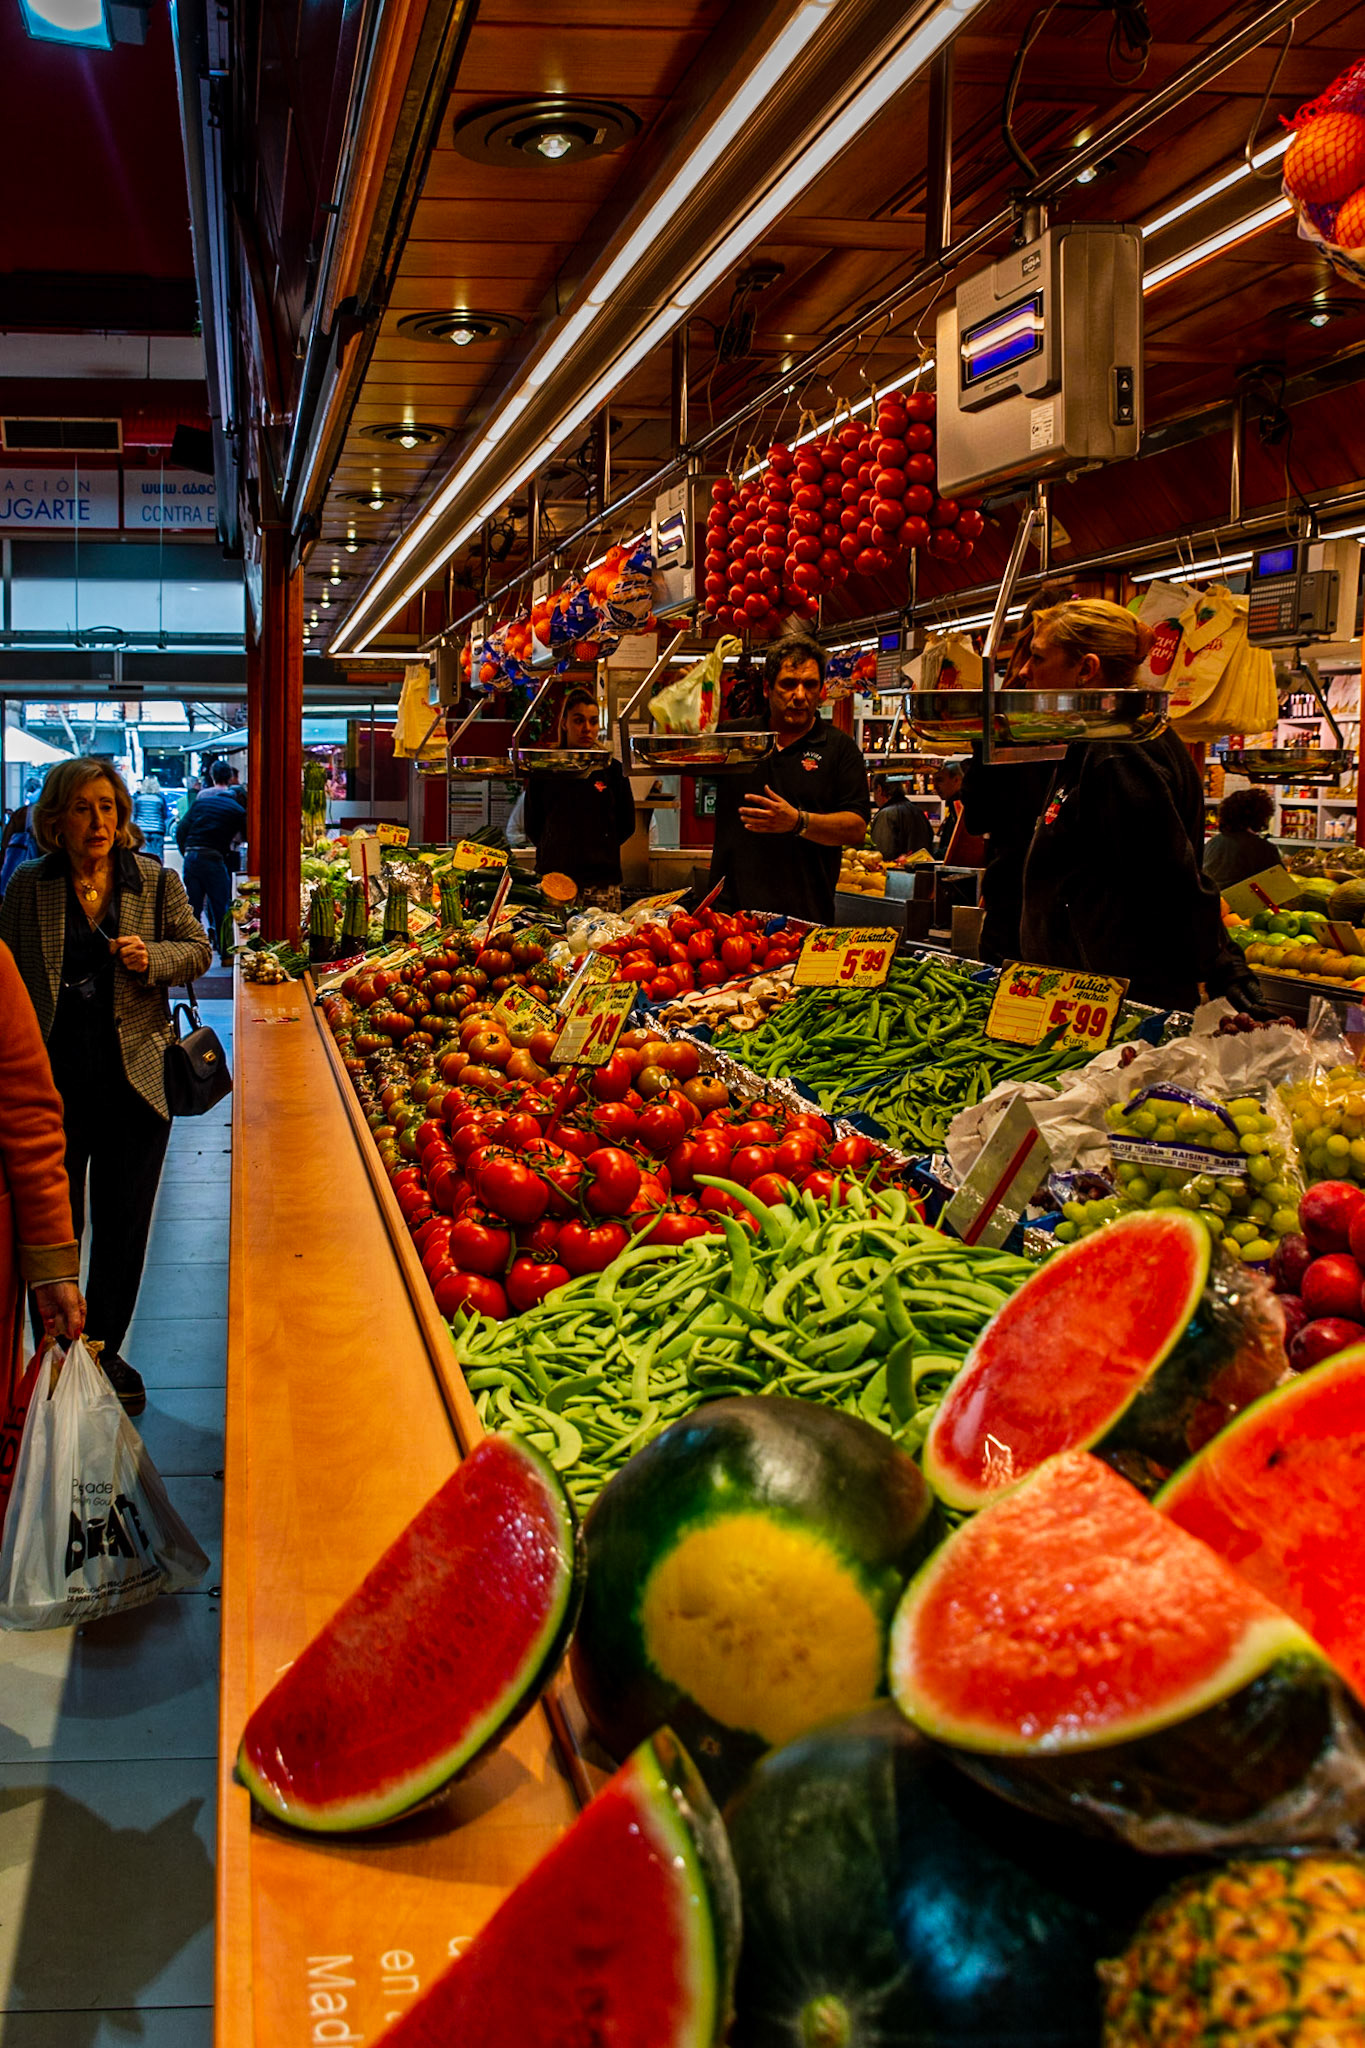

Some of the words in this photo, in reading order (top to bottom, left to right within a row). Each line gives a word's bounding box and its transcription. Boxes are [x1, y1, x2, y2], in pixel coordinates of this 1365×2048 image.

[4, 476, 91, 492] ACIÓN
[142, 505, 202, 522] CONTRA
[1171, 1150, 1210, 1163] RAISINS
[1214, 1158, 1241, 1168] SANS
[380, 1949, 421, 1996] en
